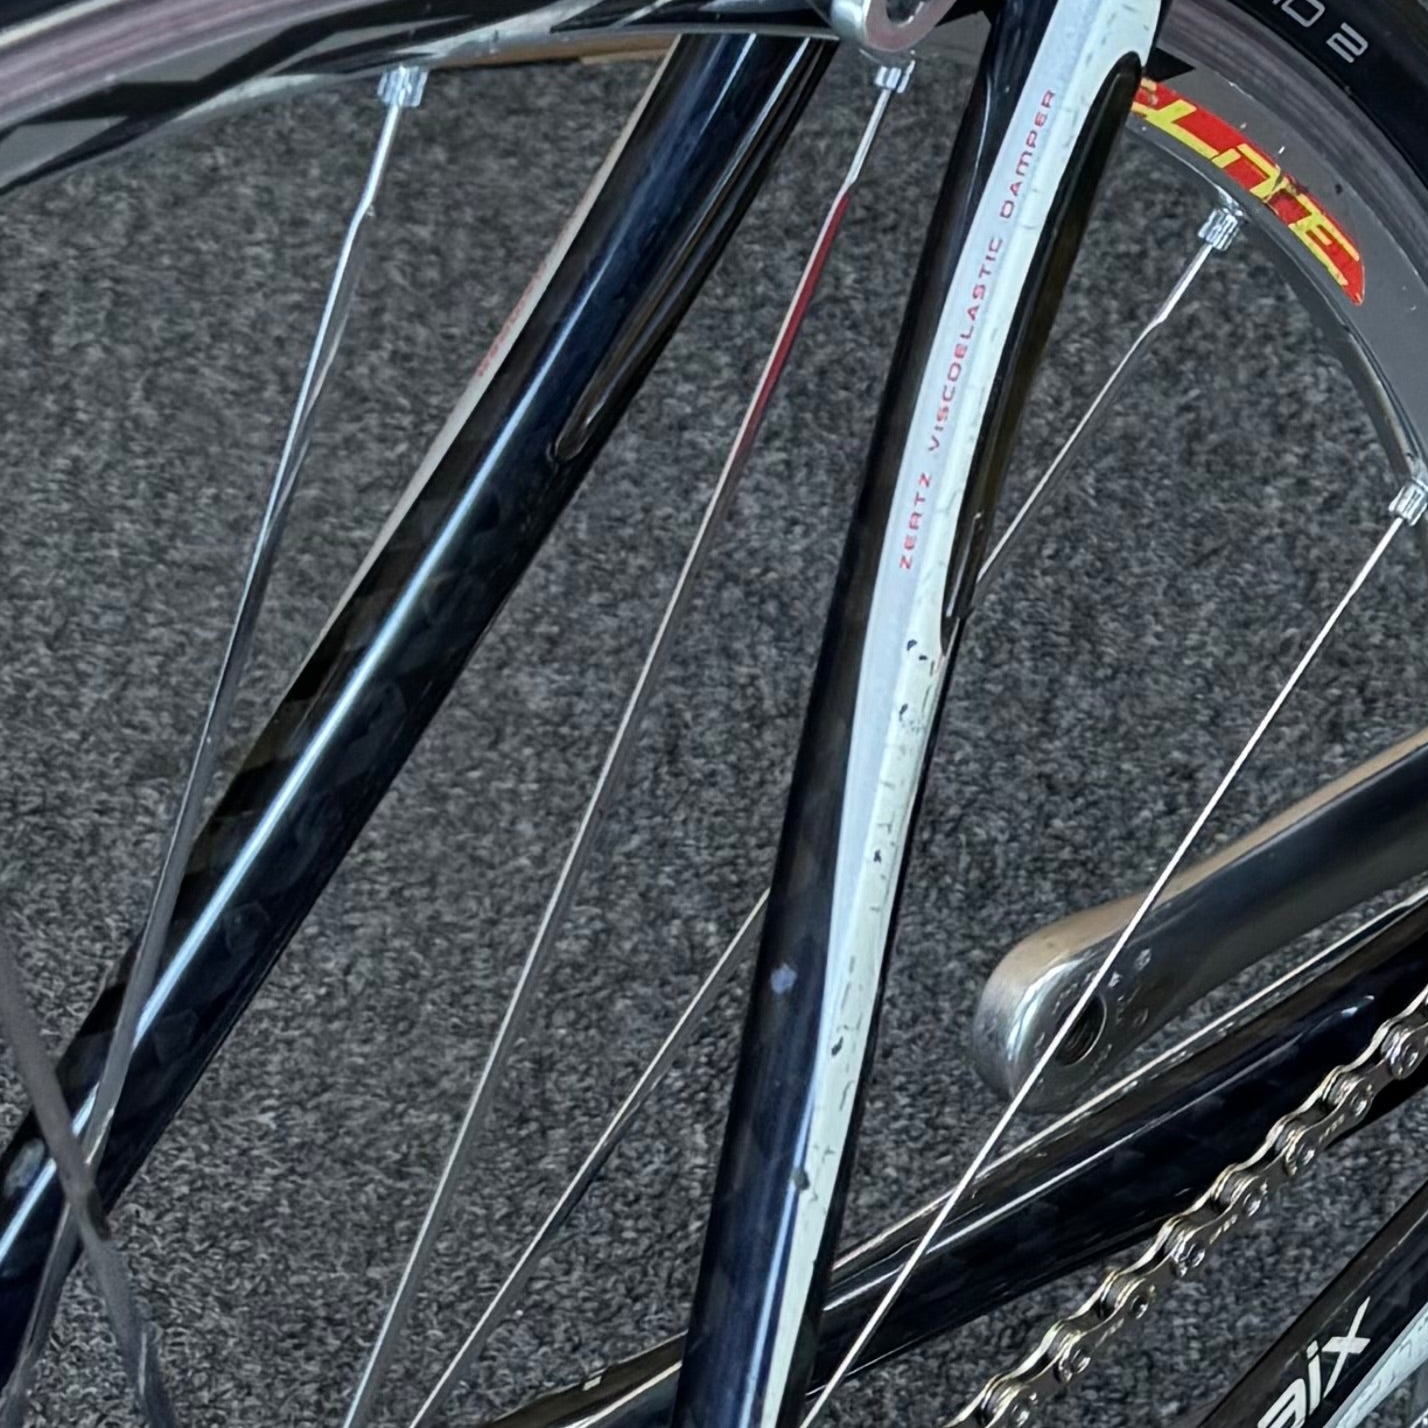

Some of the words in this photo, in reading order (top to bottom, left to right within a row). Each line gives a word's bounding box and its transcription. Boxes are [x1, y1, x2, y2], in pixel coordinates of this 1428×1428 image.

[1325, 21, 1369, 64] 2
[899, 470, 933, 571] ZERTZ
[927, 234, 1004, 453] VISCOELASTIC
[999, 88, 1057, 221] DAMPER
